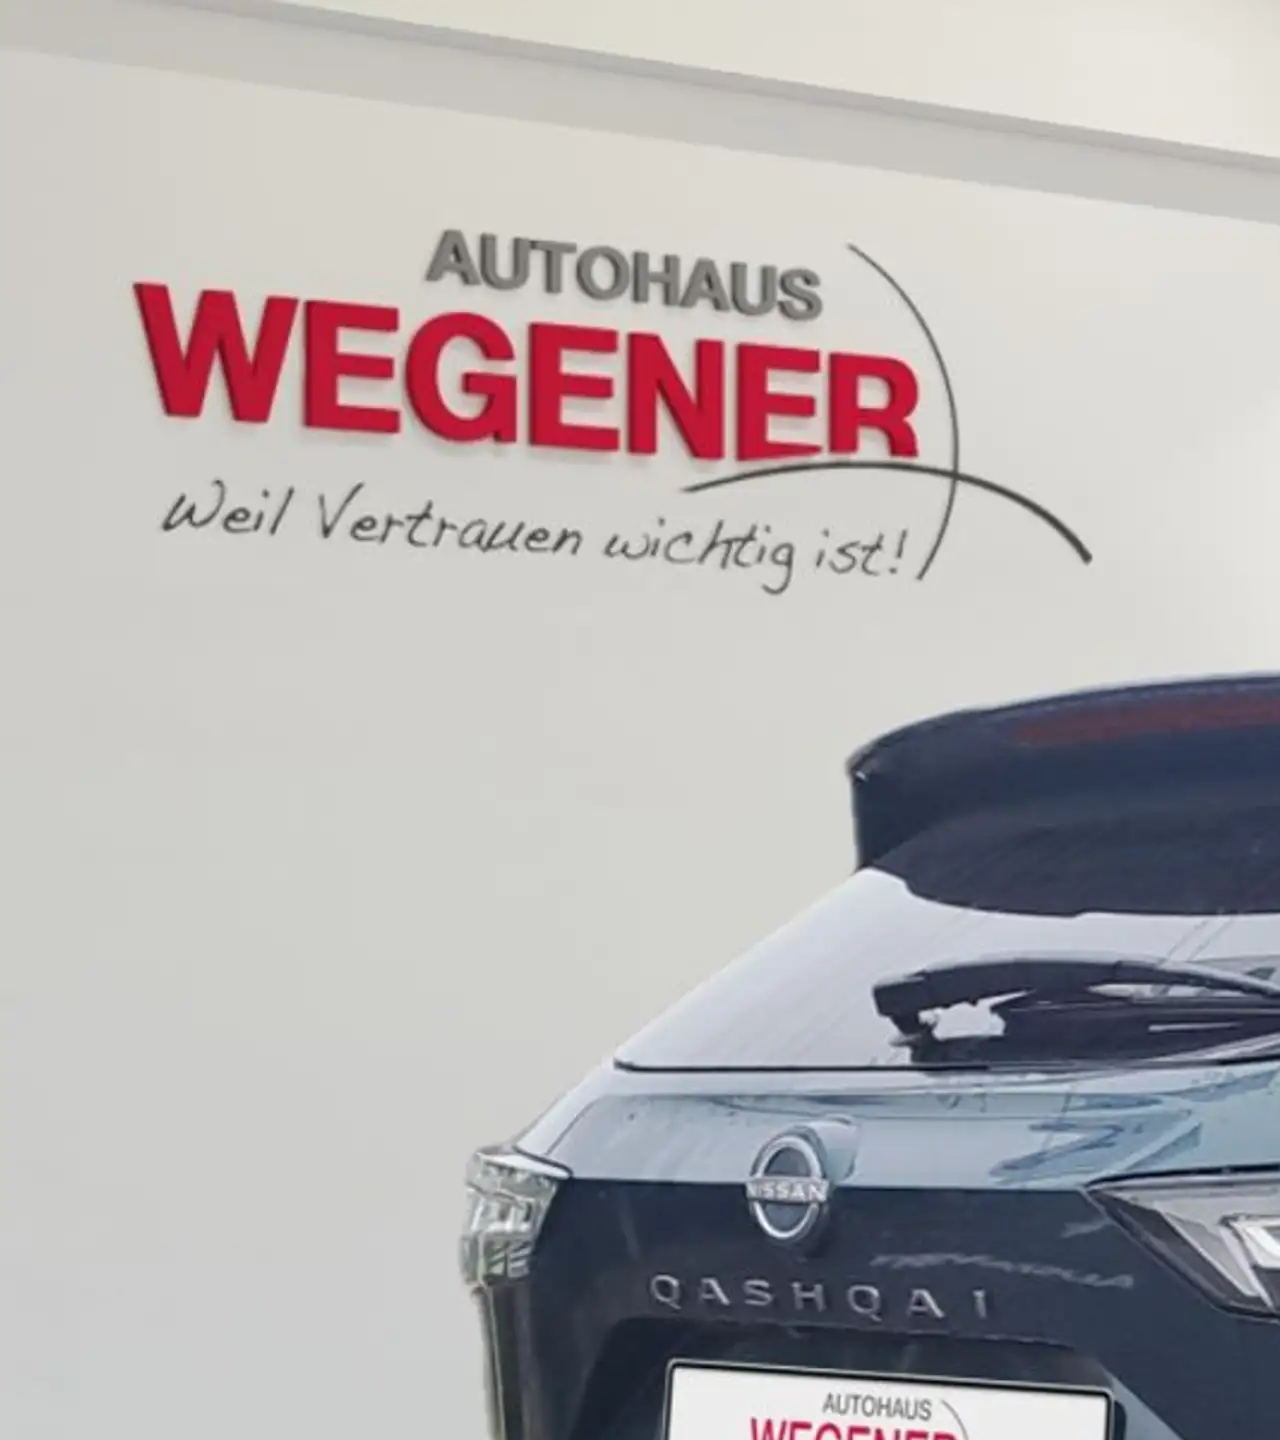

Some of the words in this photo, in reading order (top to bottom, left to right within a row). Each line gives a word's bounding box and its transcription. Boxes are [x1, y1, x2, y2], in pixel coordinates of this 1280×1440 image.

[424, 229, 823, 322] AUTOHAUS
[133, 281, 920, 462] WEGENER
[162, 480, 295, 536] Weil
[318, 482, 583, 555] Vertrauen
[604, 518, 794, 595] wichtig
[815, 530, 908, 576] ist!
[746, 1179, 829, 1203] NISSAN
[650, 1274, 990, 1322] QASHQAI
[822, 1392, 932, 1422] AUTOHAUS
